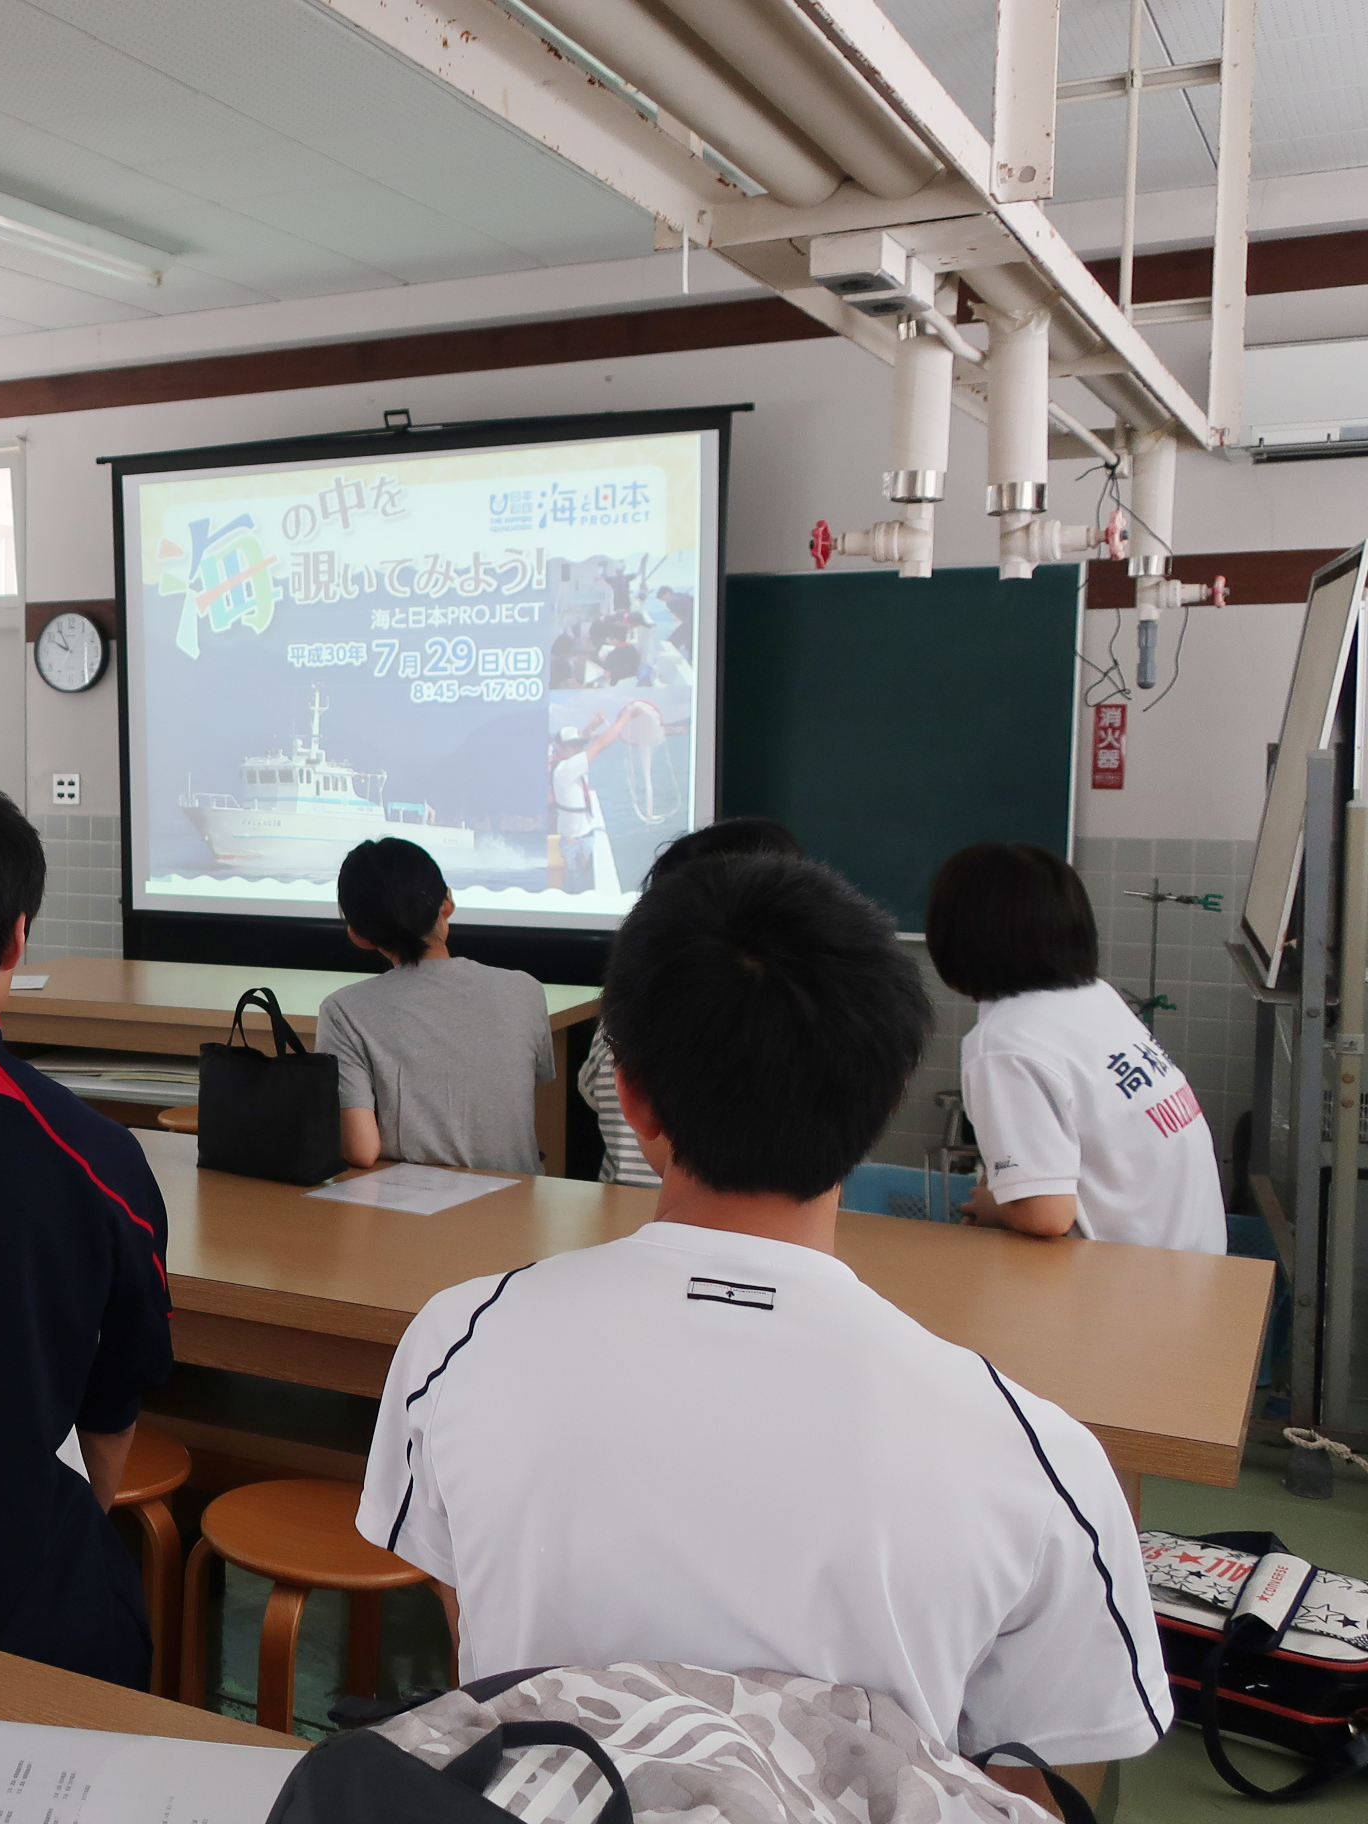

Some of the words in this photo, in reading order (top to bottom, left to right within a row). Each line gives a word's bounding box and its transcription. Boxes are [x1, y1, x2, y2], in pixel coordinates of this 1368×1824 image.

[579, 510, 650, 526] PROJECT
[370, 602, 544, 630] 海と日本PROJECT
[1262, 1564, 1289, 1598] CONVERSE
